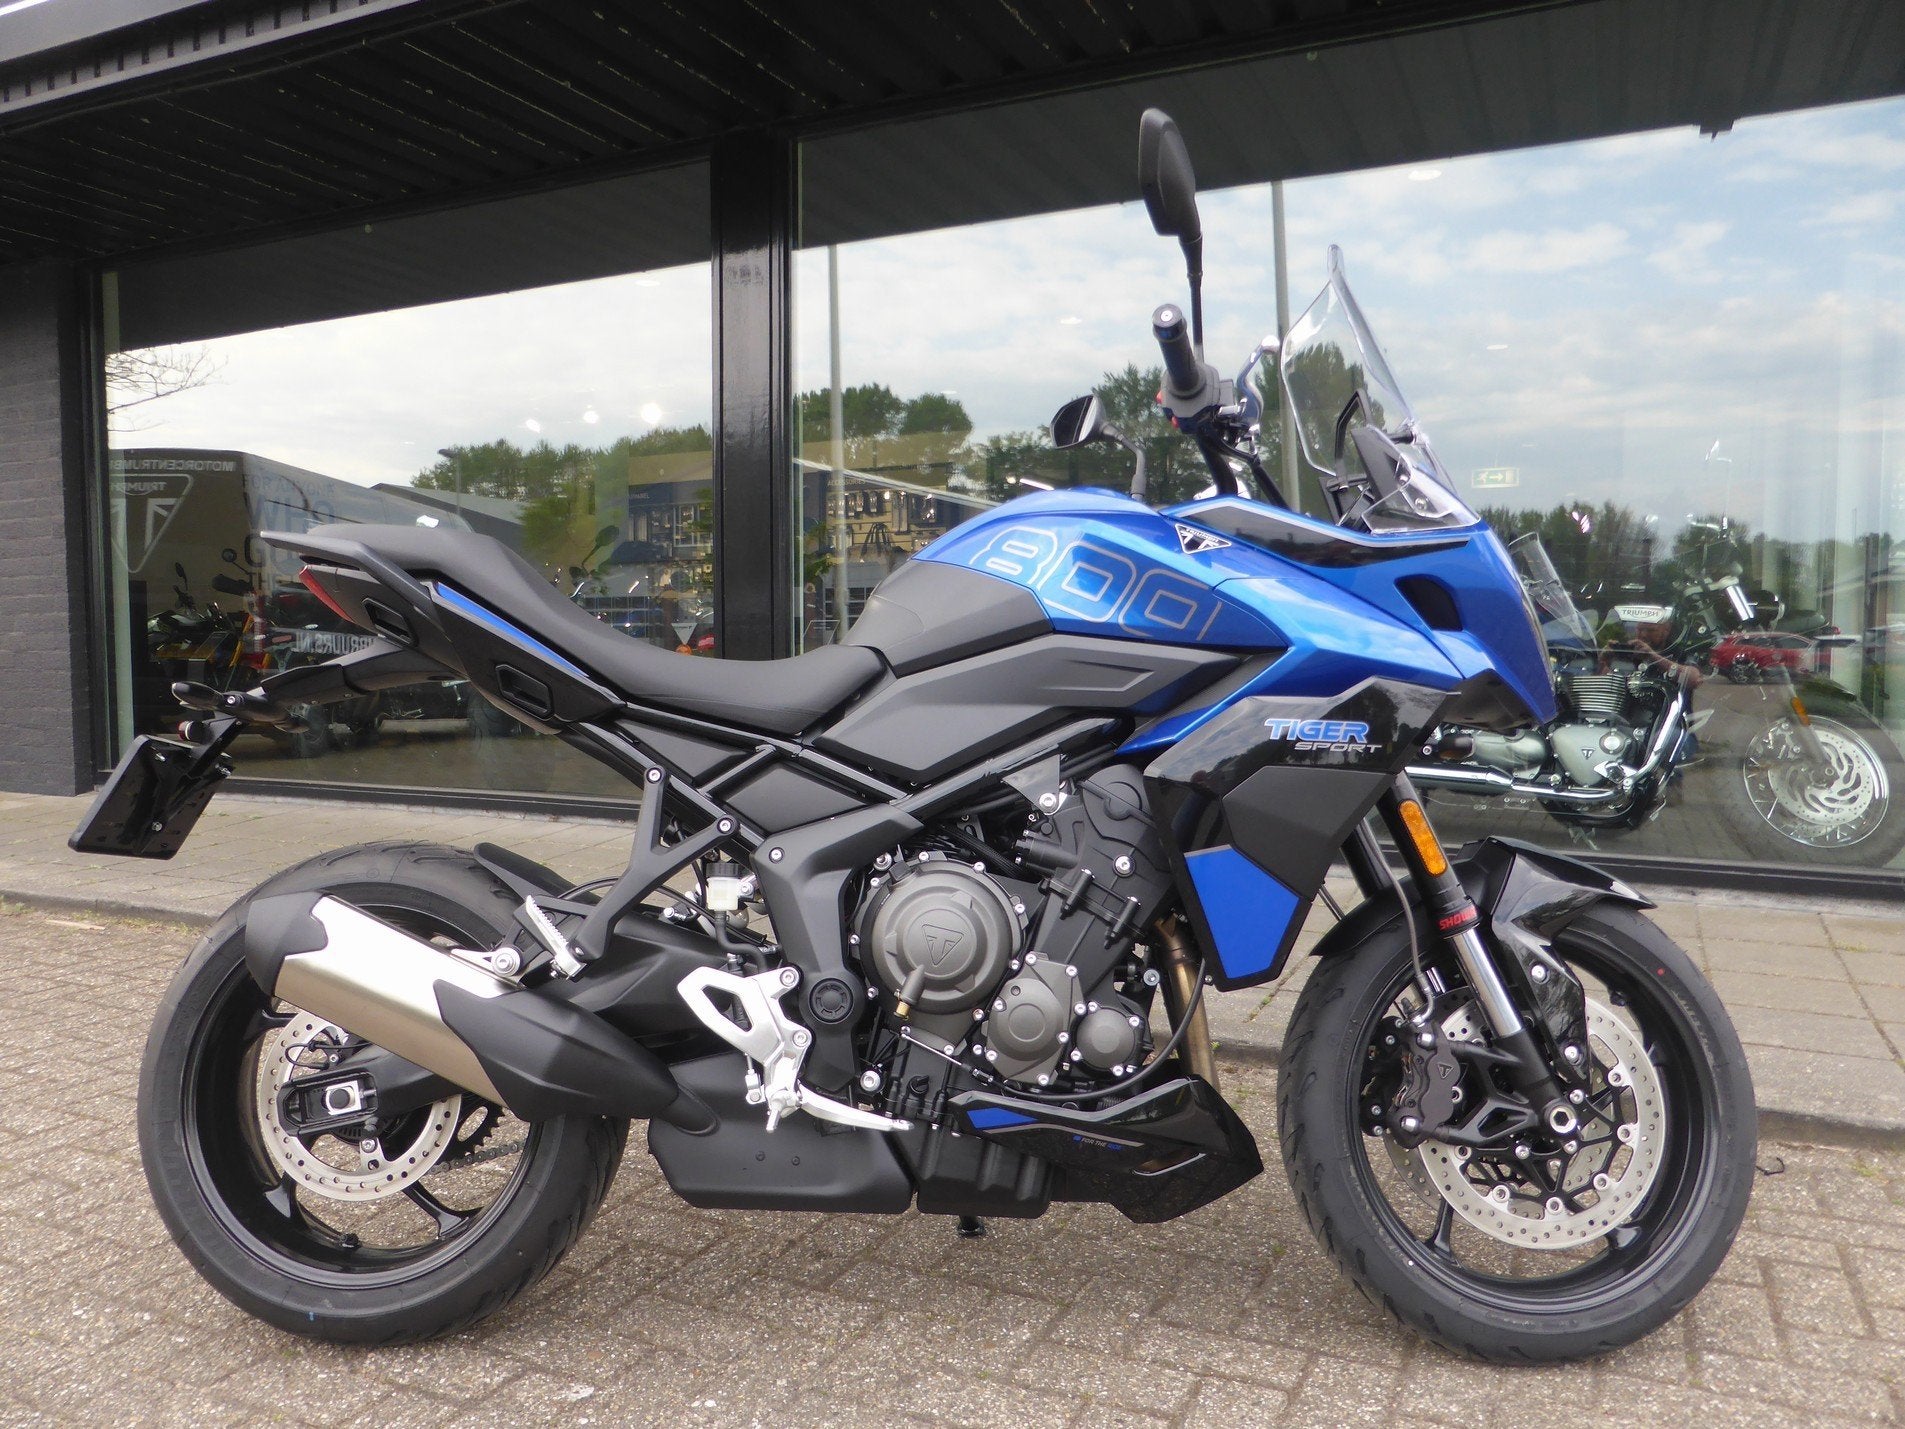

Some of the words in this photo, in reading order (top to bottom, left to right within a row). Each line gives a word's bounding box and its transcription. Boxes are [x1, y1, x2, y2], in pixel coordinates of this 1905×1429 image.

[969, 528, 1222, 640] 800
[1622, 608, 1659, 617] TRIUMPH
[1264, 718, 1369, 744] TIGER
[1294, 741, 1382, 754] SPORT
